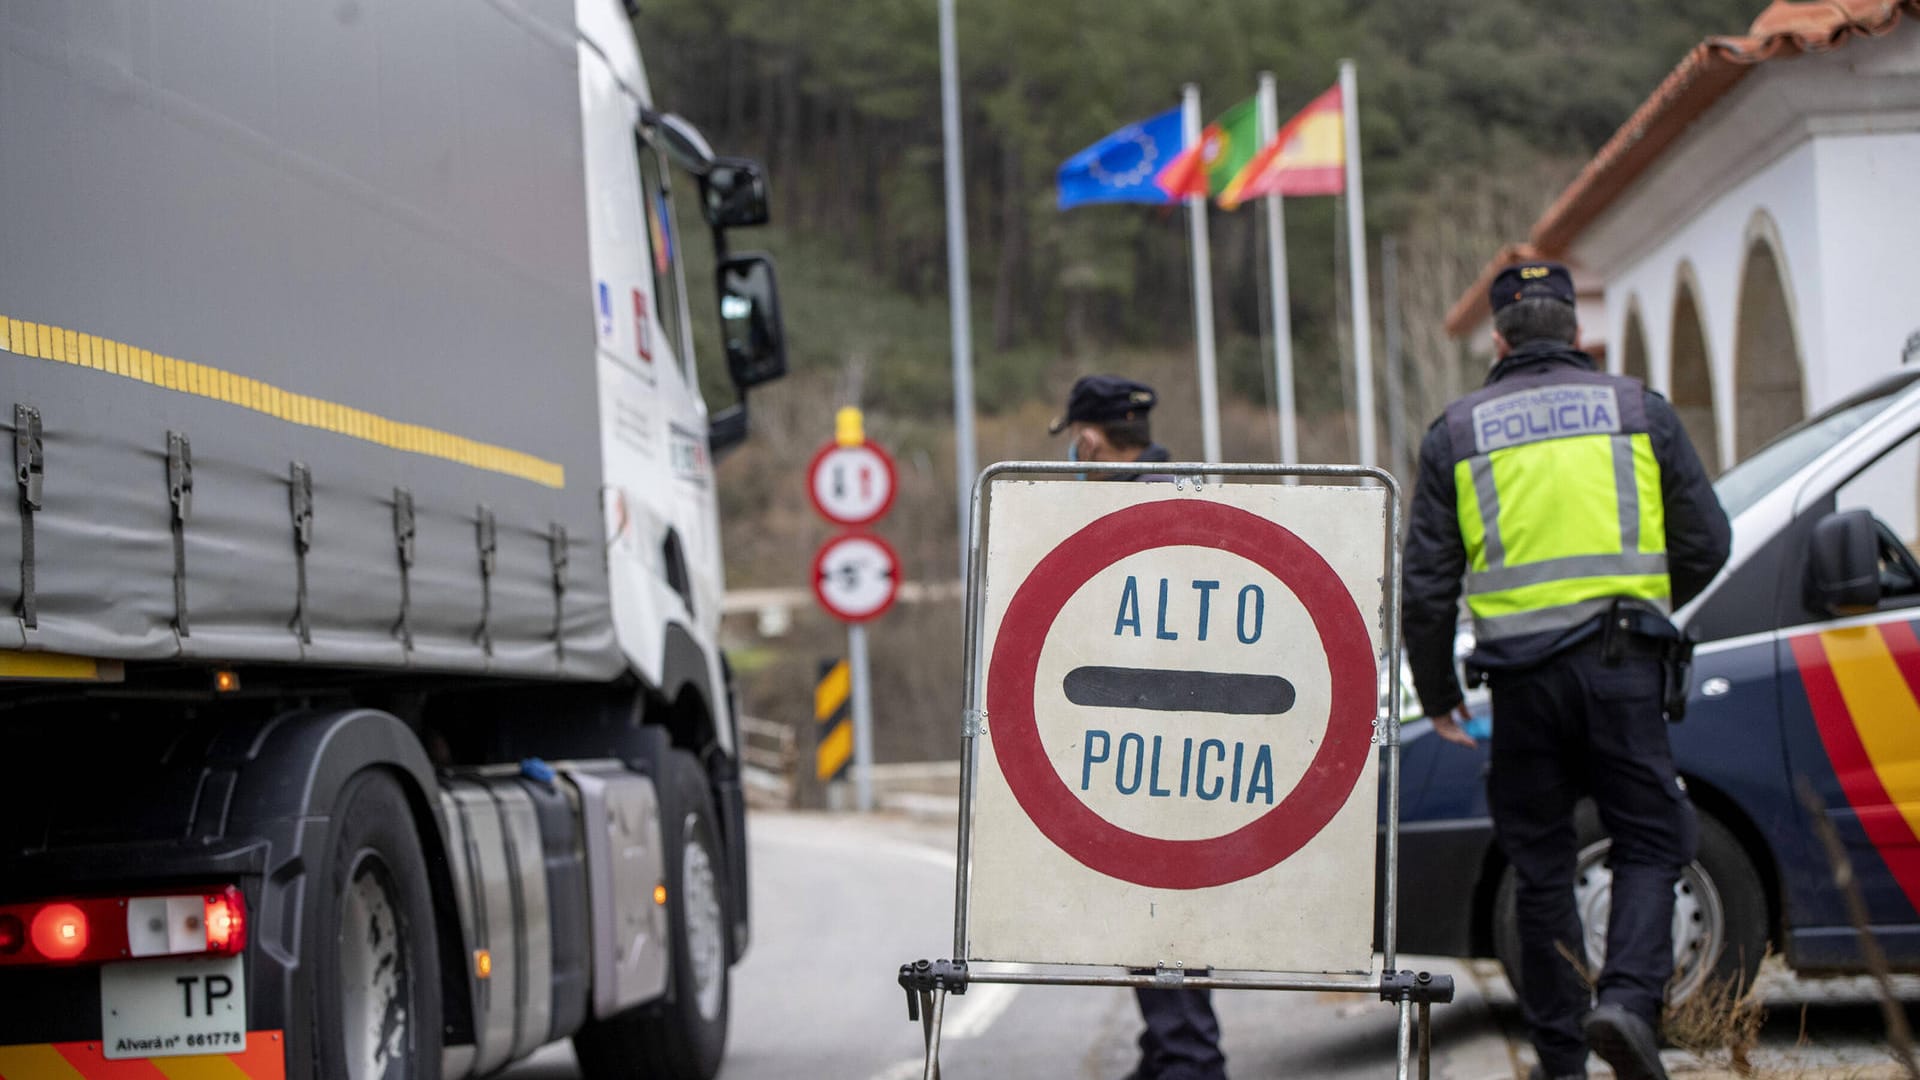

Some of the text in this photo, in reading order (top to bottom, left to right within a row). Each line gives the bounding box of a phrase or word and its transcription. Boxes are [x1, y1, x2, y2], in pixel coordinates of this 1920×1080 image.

[1482, 404, 1613, 446] POLICIA
[1114, 575, 1264, 645] ALTO
[1081, 729, 1275, 805] POLICIA
[176, 974, 233, 1018] TP
[116, 1036, 162, 1052] Alvará
